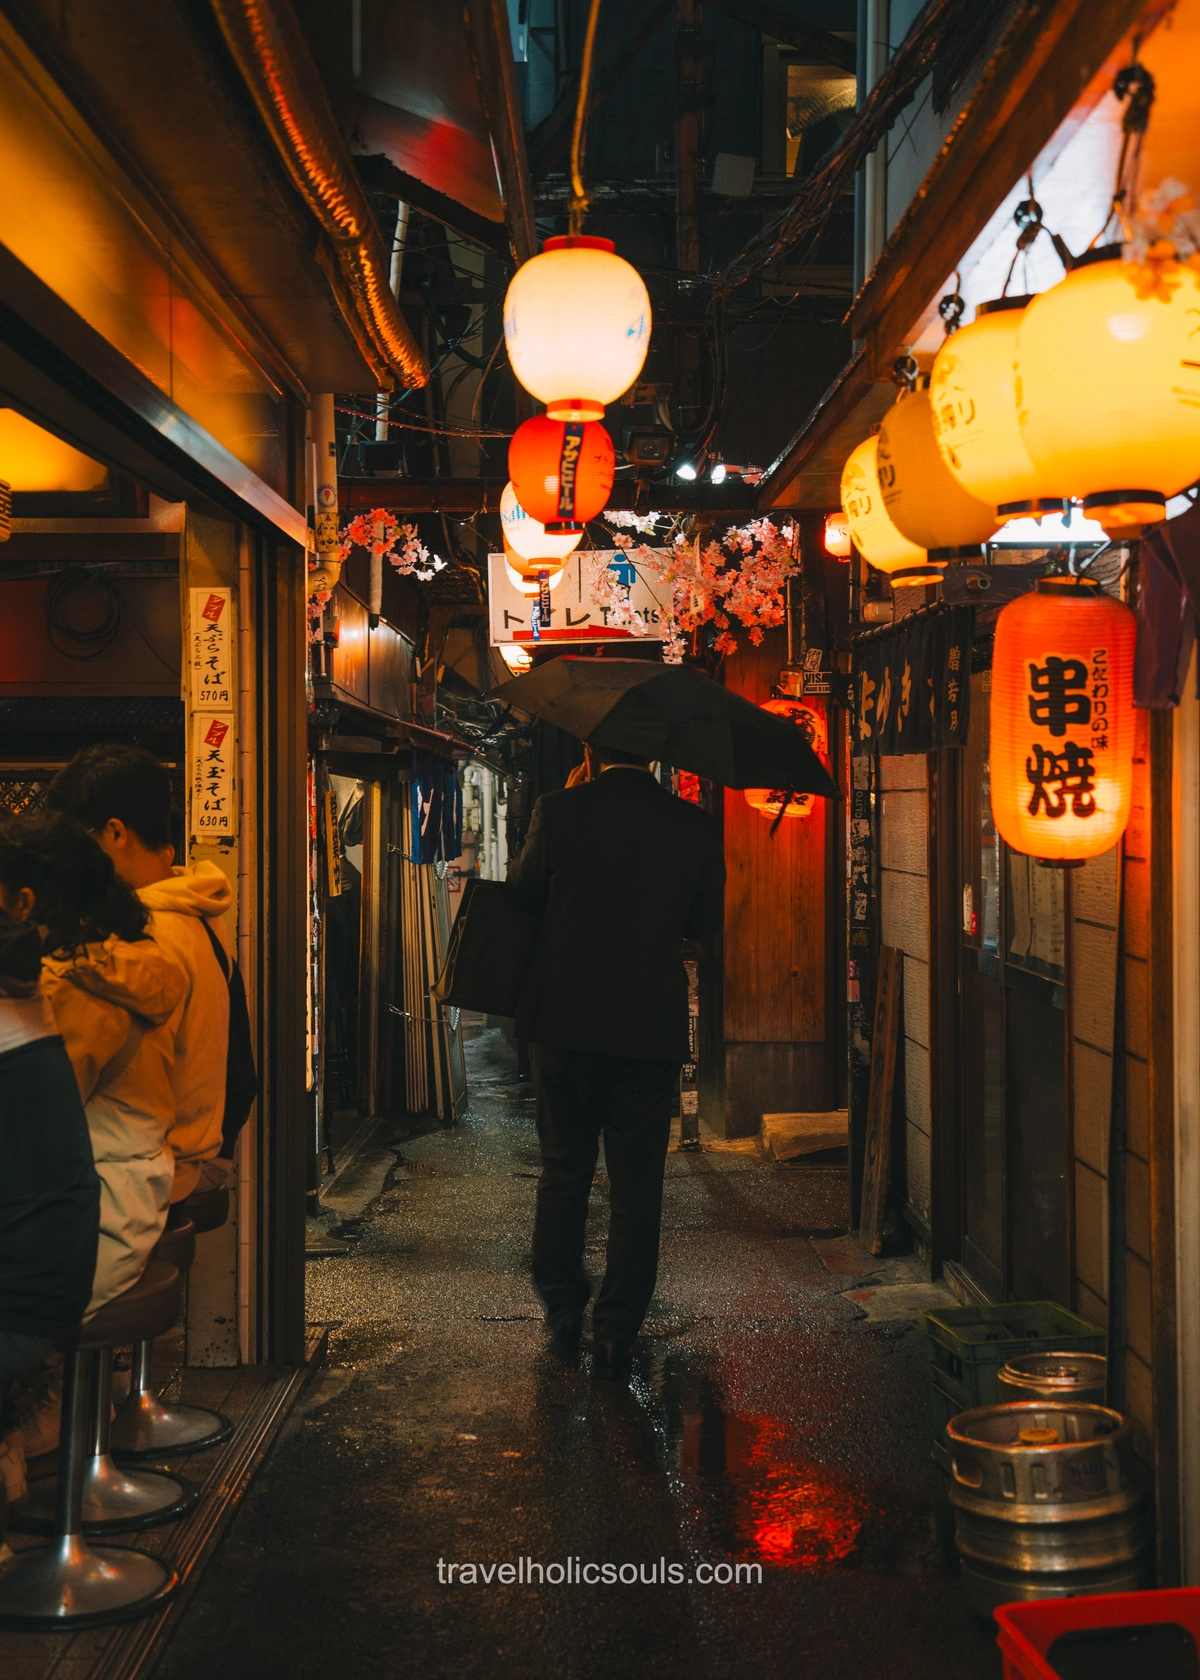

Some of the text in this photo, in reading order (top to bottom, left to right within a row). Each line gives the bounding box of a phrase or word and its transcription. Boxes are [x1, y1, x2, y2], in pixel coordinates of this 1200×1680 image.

[560, 435, 580, 511] アサヒビール
[503, 607, 590, 629] トレ
[202, 624, 226, 685] 天ぷらそば
[200, 689, 229, 702] 570円
[1091, 649, 1108, 751] こだわりの味
[1027, 655, 1096, 819] 串焼
[204, 750, 226, 812] 天玉そば
[199, 815, 228, 828] 630円
